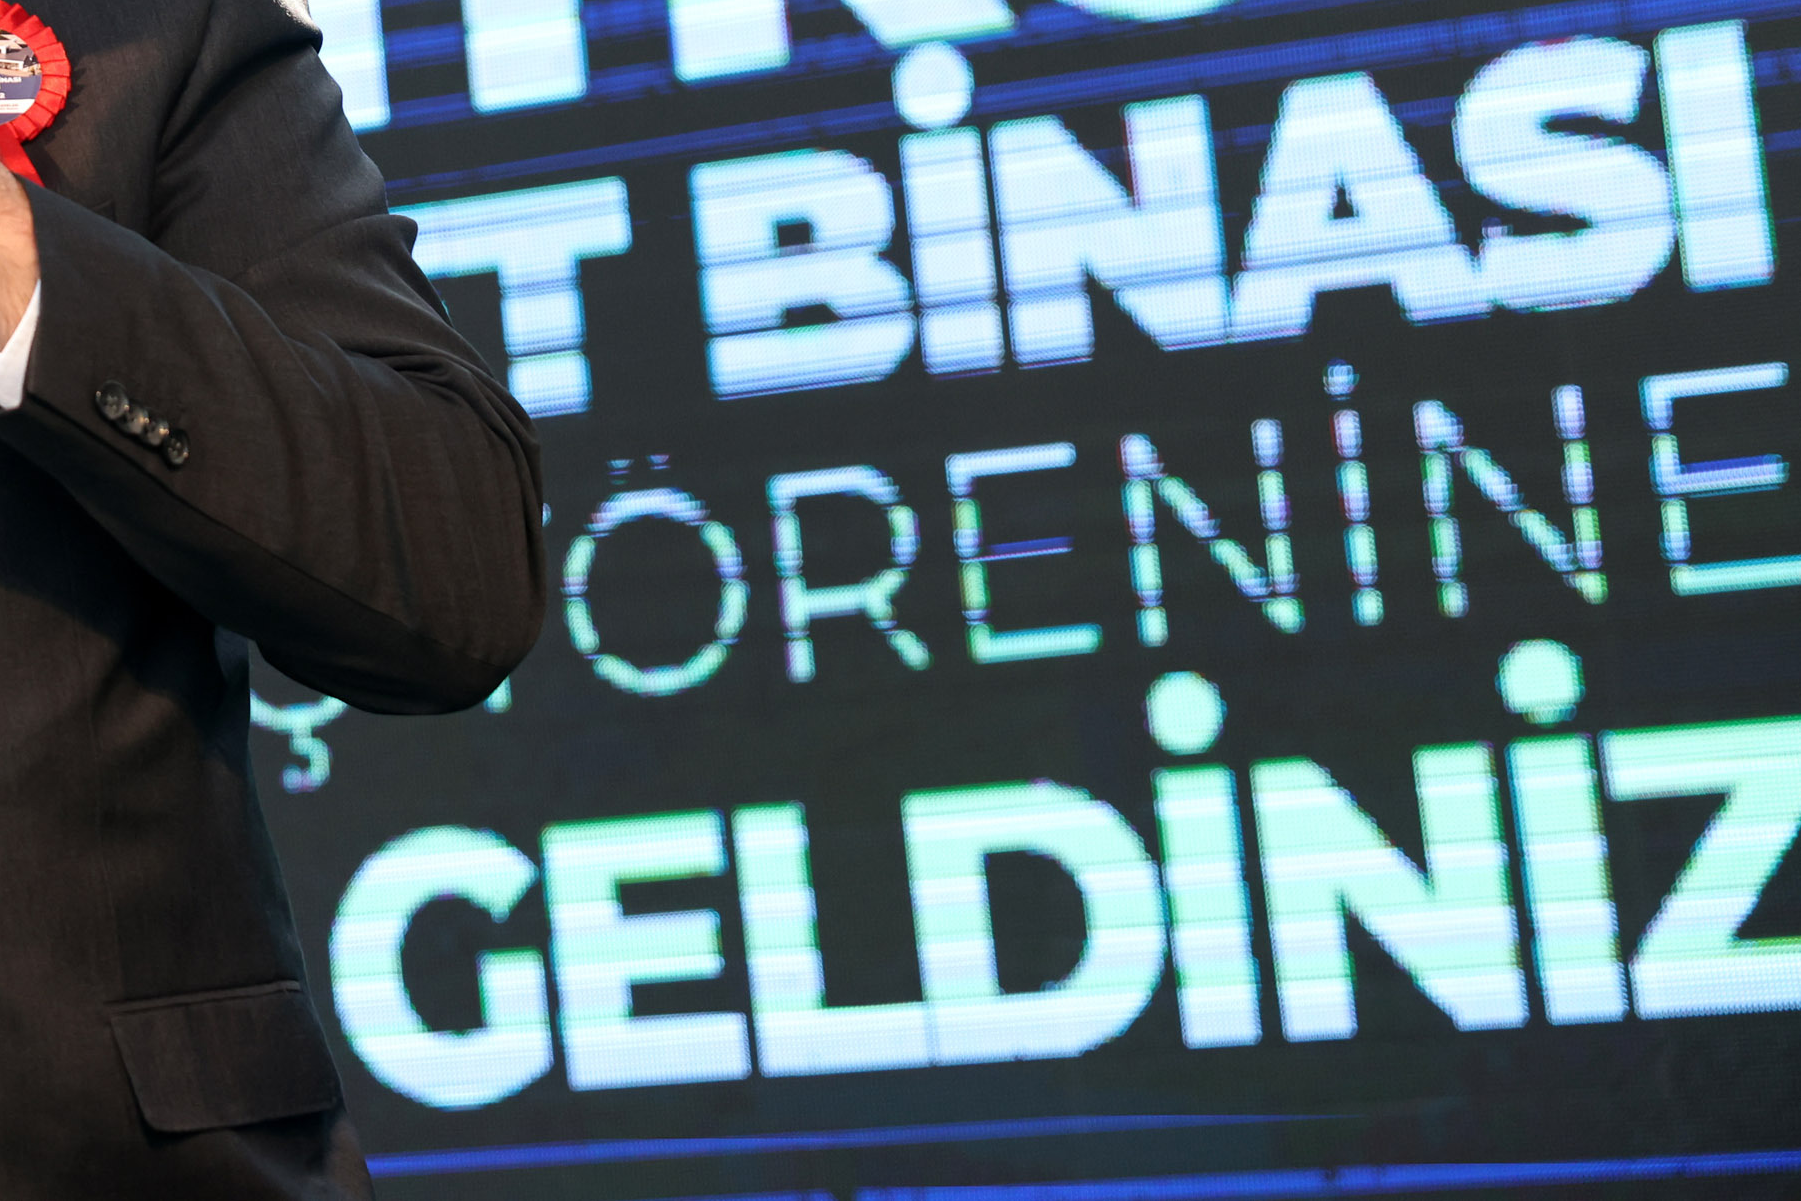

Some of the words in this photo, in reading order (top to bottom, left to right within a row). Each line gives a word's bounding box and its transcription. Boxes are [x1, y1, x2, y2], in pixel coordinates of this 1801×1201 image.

[687, 19, 1778, 401] BİNASI
[483, 359, 1801, 713] ÖRENİNE
[329, 639, 1801, 1111] GELDİNİZ
